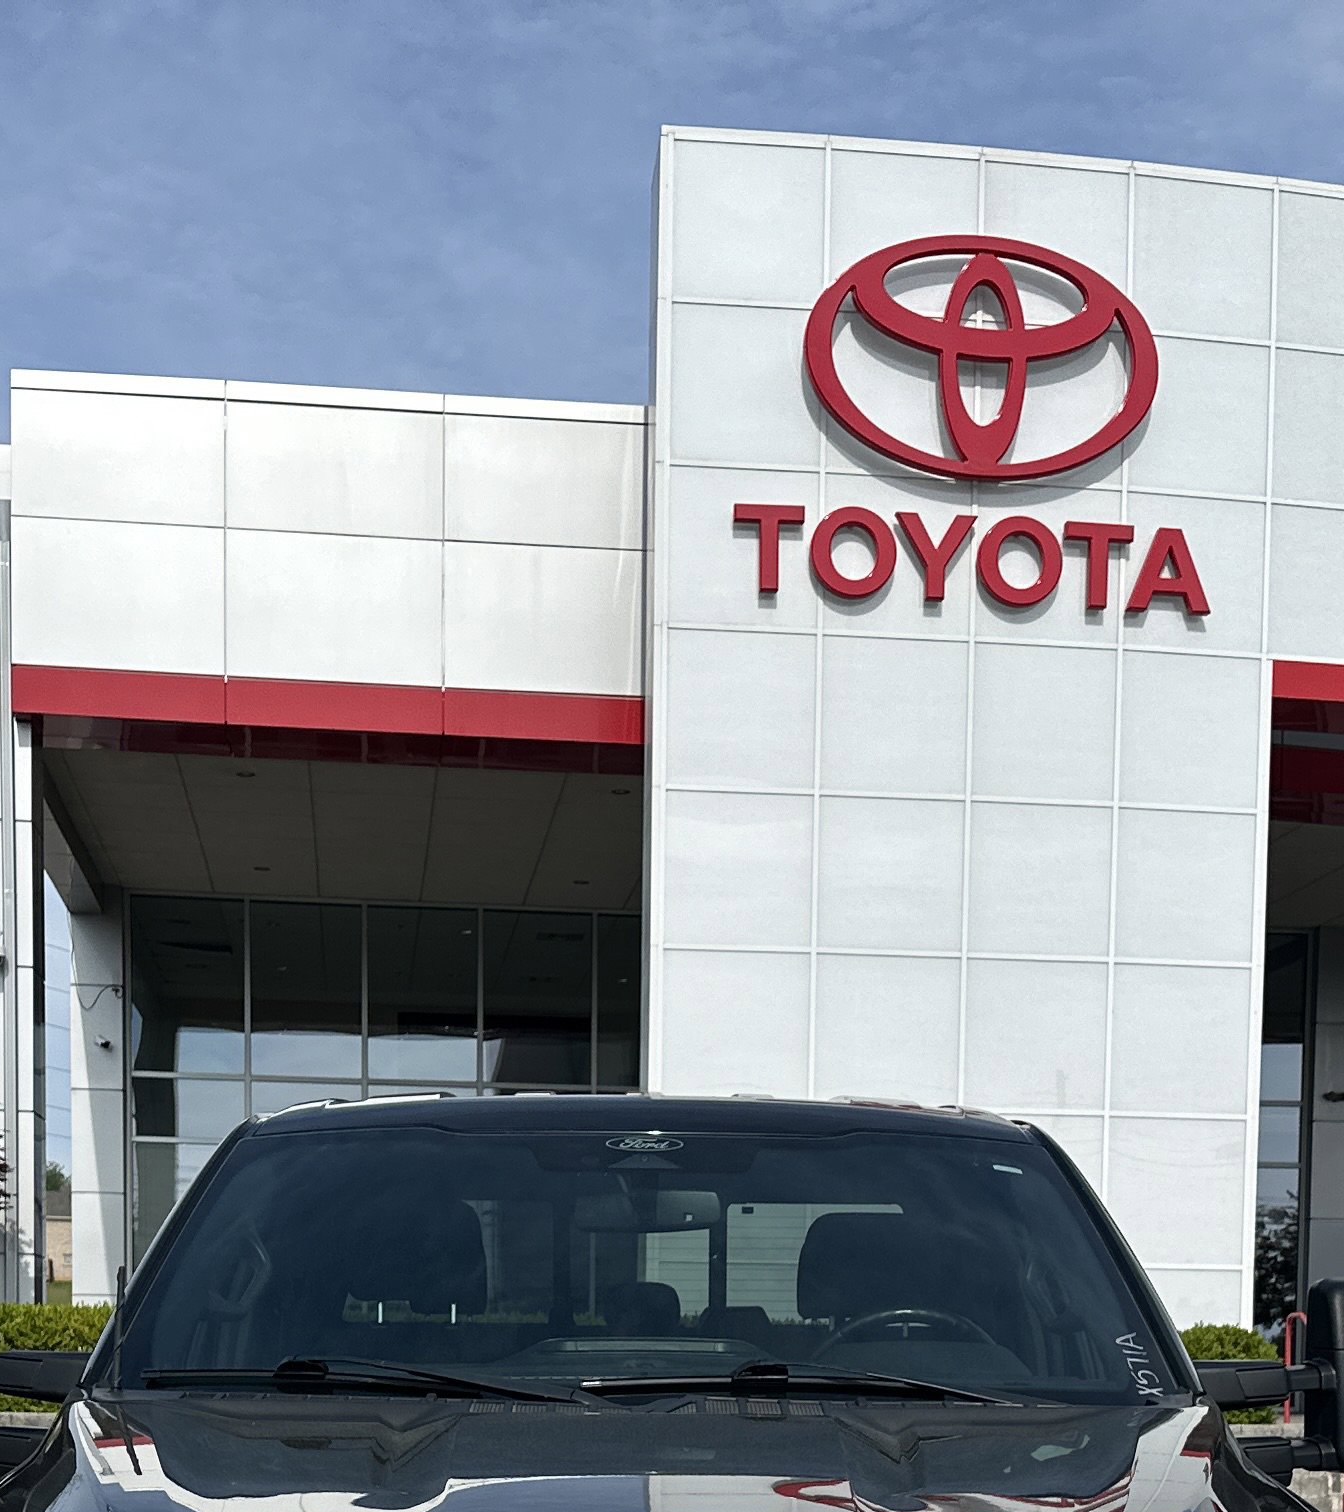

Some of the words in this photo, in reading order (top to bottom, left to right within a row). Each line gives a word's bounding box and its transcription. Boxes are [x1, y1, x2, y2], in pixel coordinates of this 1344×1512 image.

[733, 503, 1211, 617] TOYOTA
[619, 1138, 670, 1149] Ford
[1115, 1331, 1164, 1397] X571A
